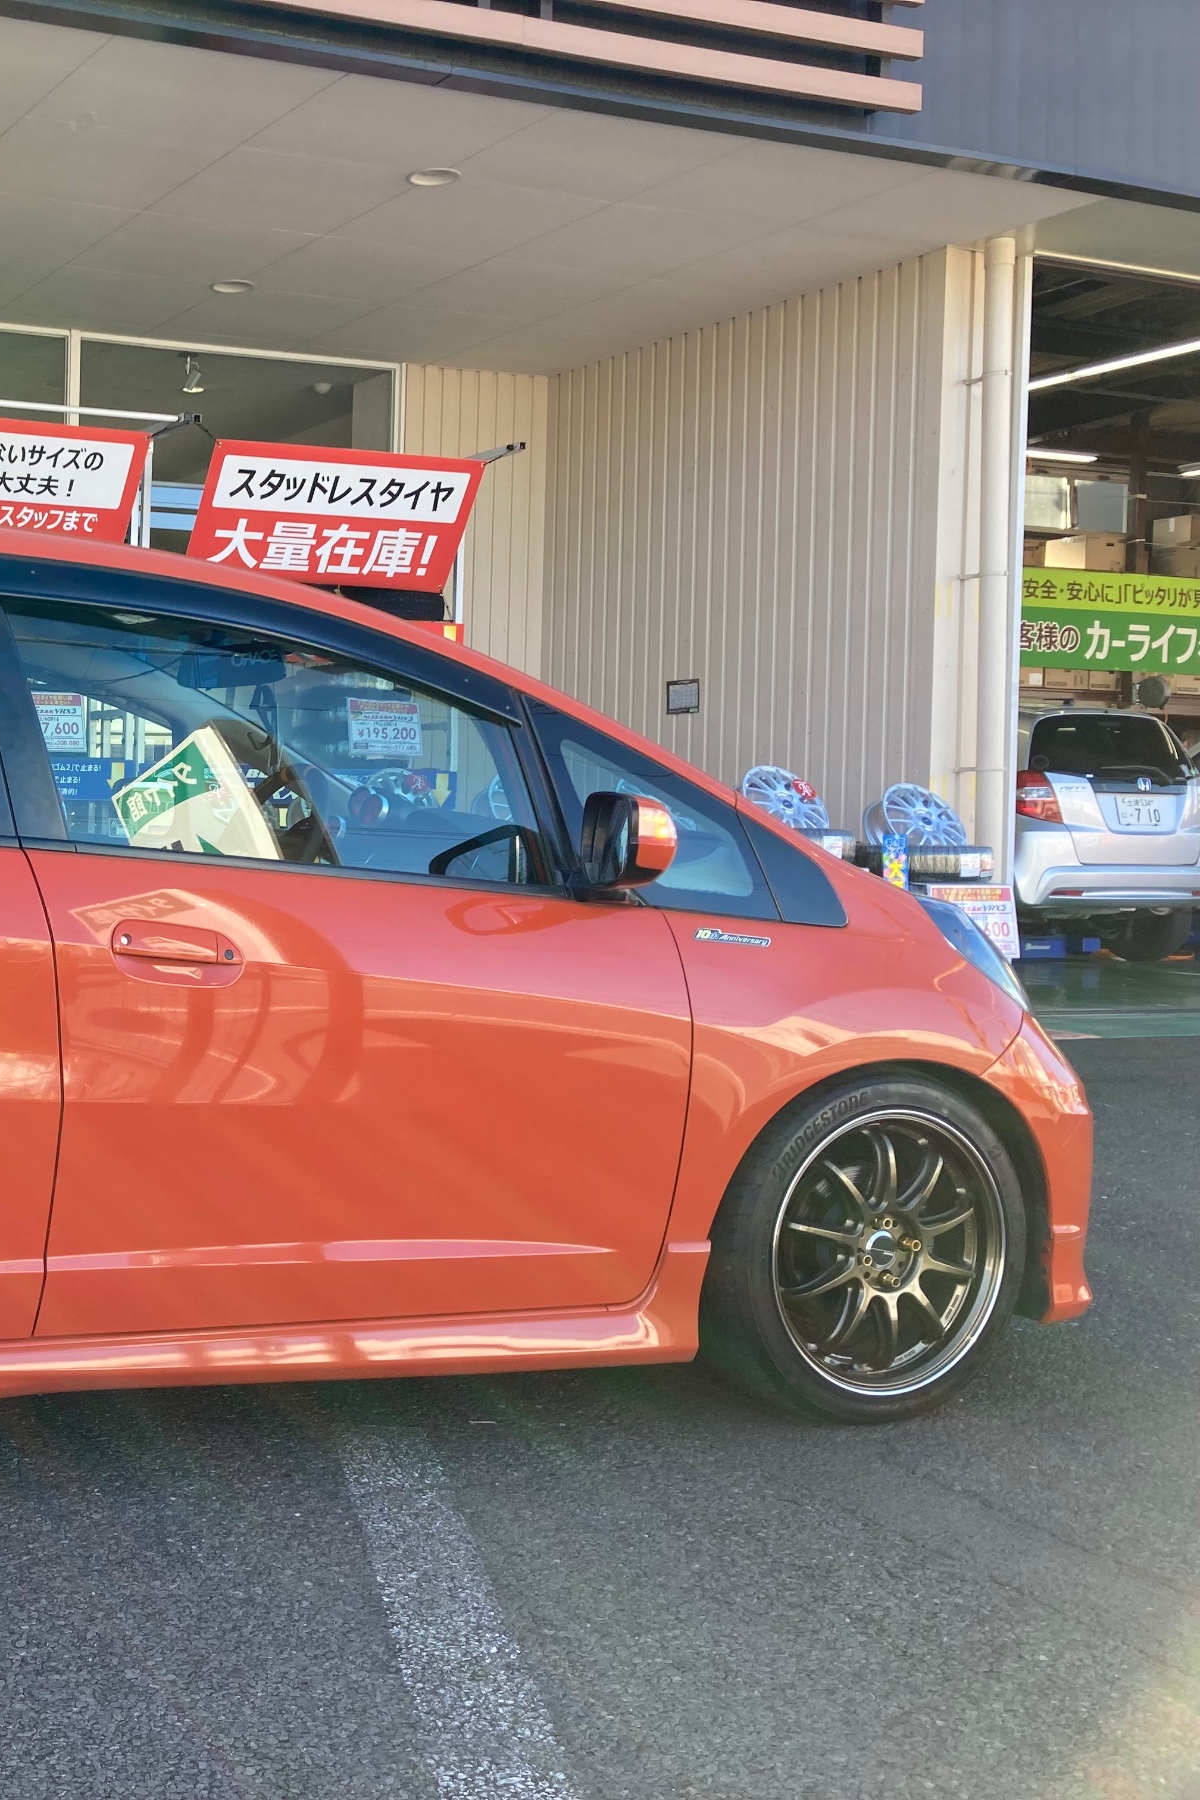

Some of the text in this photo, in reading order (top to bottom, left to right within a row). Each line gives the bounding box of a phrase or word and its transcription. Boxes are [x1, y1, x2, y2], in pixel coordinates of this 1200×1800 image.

[228, 468, 455, 512] スタッドレスタイヤ
[206, 518, 438, 578] 大量在庫!
[357, 726, 417, 741] ¥195,200
[982, 904, 1007, 912] VRX3
[719, 934, 768, 946] Anniversary
[771, 1090, 869, 1180] BRIDGESTONE
